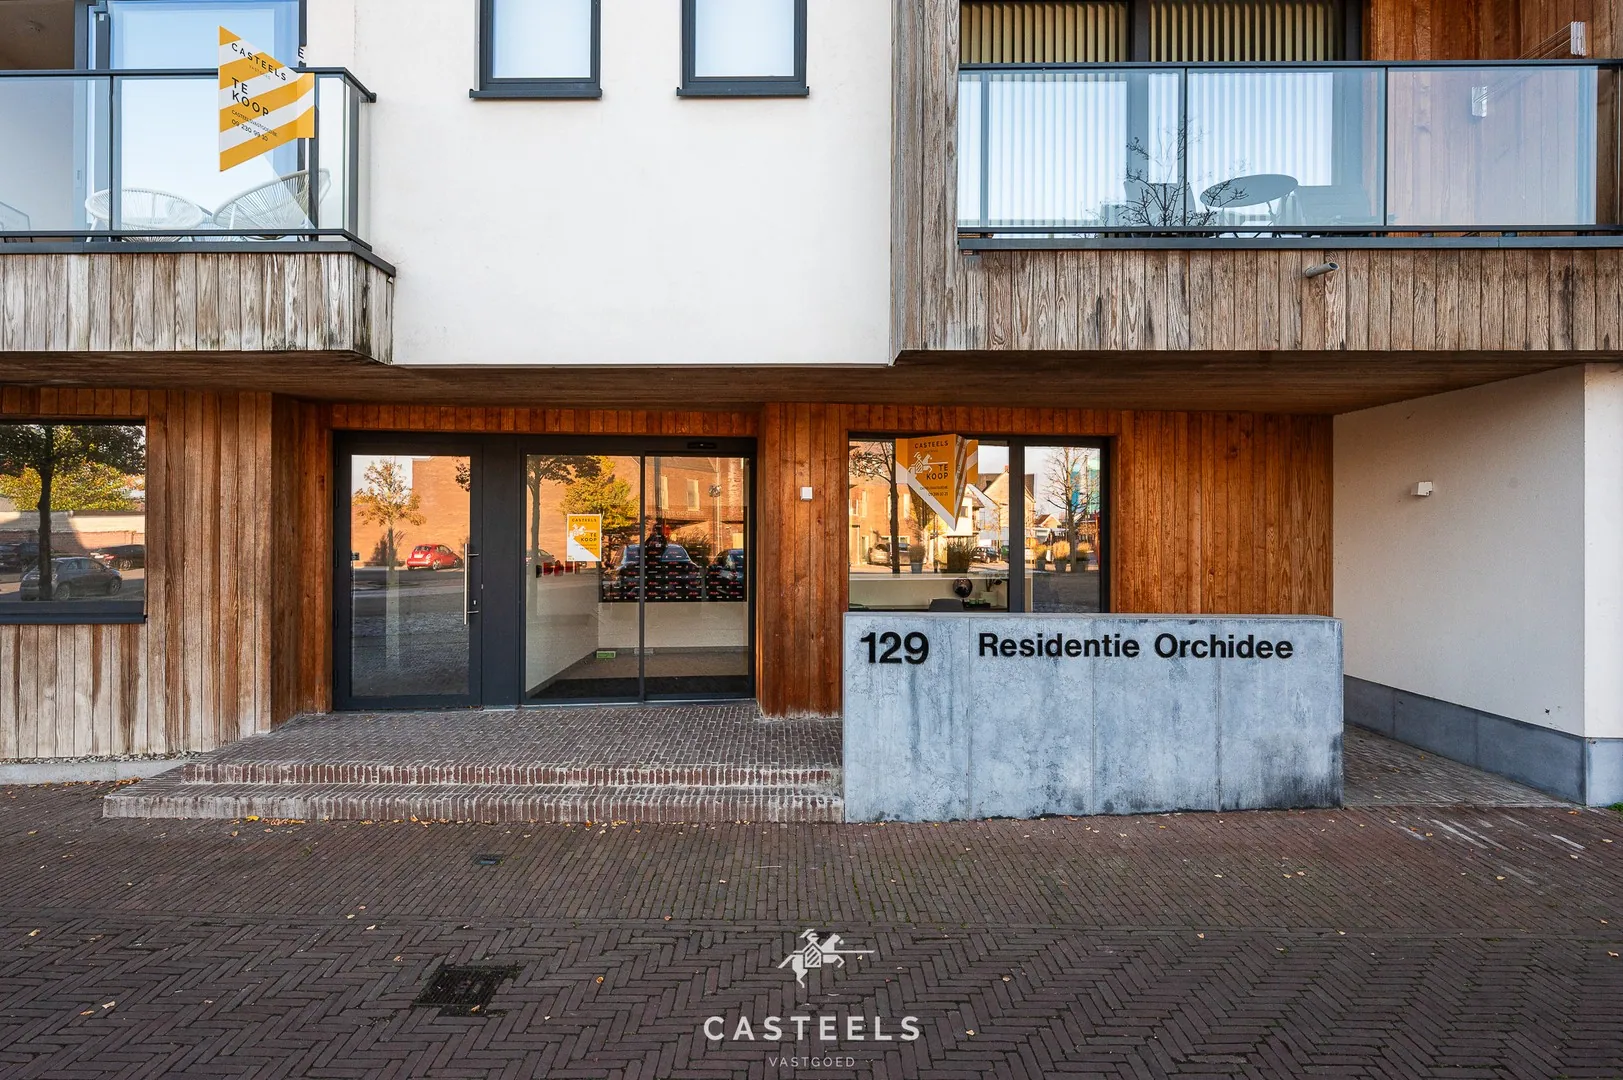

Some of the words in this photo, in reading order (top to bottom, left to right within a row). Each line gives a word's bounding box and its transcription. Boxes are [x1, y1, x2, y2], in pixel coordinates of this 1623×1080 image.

[231, 43, 286, 81] CASTEELS
[231, 77, 248, 95] TE
[232, 90, 269, 116] KOOP
[914, 440, 949, 449] CASTEELS
[926, 472, 949, 480] KOOP
[938, 463, 949, 472] TE
[860, 631, 930, 665] 129
[978, 632, 1140, 658] Residentie
[1154, 632, 1294, 659] Orchidee
